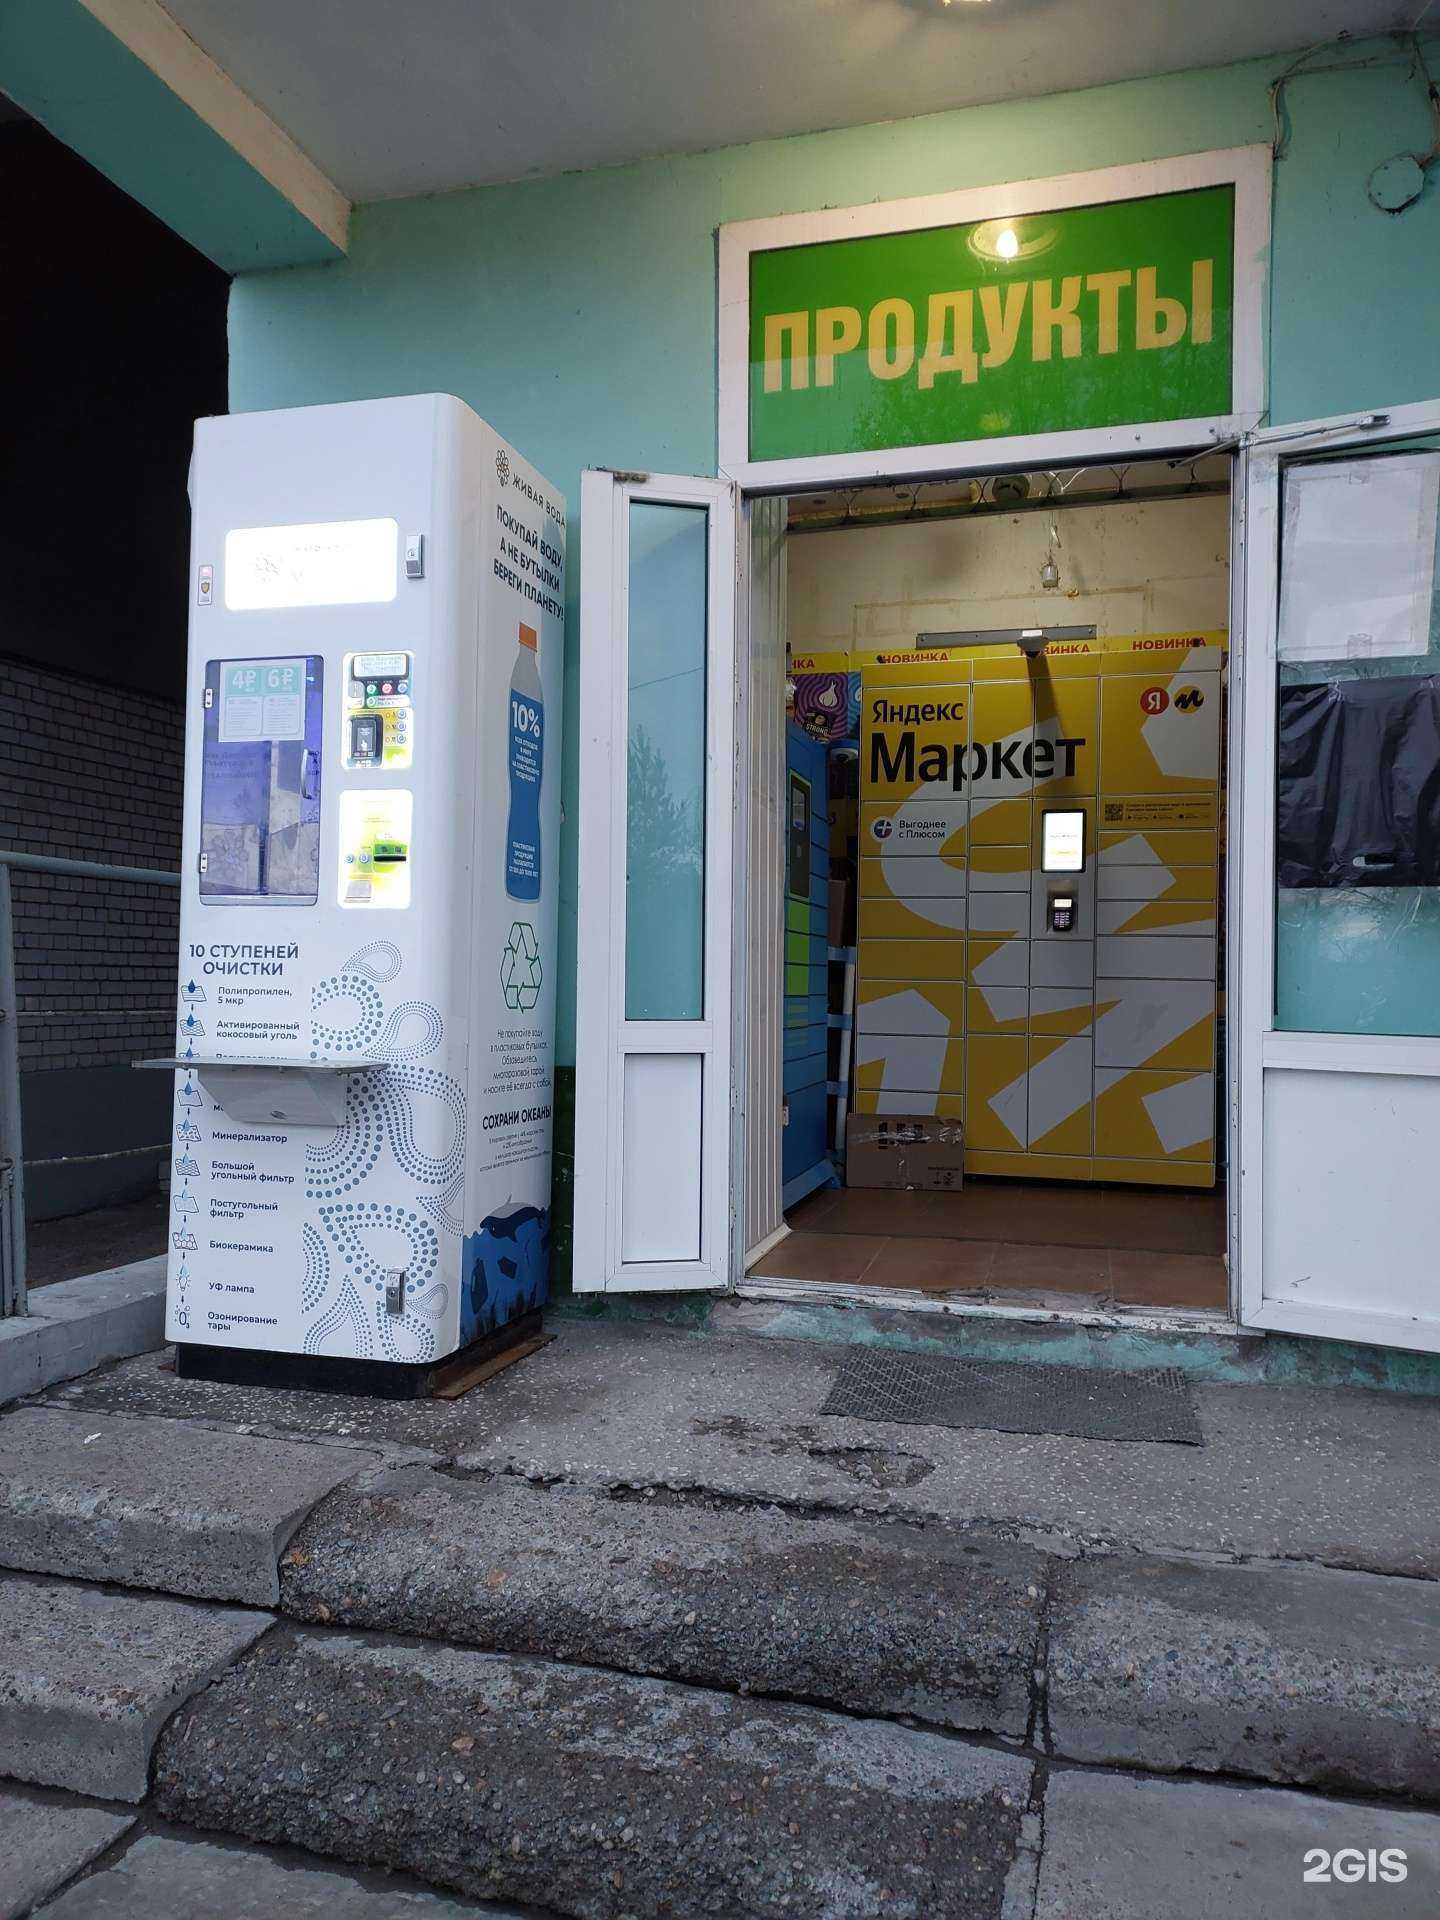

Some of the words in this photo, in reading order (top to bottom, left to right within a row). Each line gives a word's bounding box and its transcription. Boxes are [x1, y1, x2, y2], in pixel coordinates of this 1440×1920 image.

[763, 259, 1214, 394] ПРОДУКТЫ
[512, 473, 544, 509] ЖИВАЯ
[545, 501, 566, 529] ВОДА
[496, 503, 539, 550] ПОКУПАЙ
[540, 538, 563, 573] ВОДУ,
[500, 537, 507, 555] А
[508, 541, 519, 564] НЕ
[520, 551, 560, 593] БУТЫЛКИ
[493, 558, 522, 594] БЕРЕГИ
[524, 583, 564, 621] ПЛАНЕТУ!
[1132, 636, 1207, 651] НОВИНКА
[882, 651, 949, 664] НОВИНКА
[1147, 691, 1161, 710] Я
[871, 699, 964, 725] Яндекс
[512, 700, 541, 738] 10%
[805, 722, 829, 735] STRONG
[870, 731, 1086, 792] Маркет
[899, 819, 947, 831] Выгоднее
[906, 830, 945, 839] Плюсом
[189, 944, 206, 957] 10
[209, 942, 299, 959] СТУПЕНЕЙ
[203, 961, 283, 976] ОЧИСТКИ
[218, 986, 293, 997] Полипропилен,
[217, 996, 223, 1004] 5
[225, 997, 244, 1006] мкр
[216, 1020, 300, 1030] Активированный
[216, 1030, 268, 1039] кокосовый
[270, 1032, 298, 1041] уголь
[482, 1110, 520, 1130] СОХРАНИ
[212, 1131, 288, 1144] Минерализатор
[211, 1160, 255, 1171] Большой
[211, 1171, 257, 1181] угольный
[258, 1173, 295, 1184] фильтр
[210, 1199, 279, 1212] Постугольный
[209, 1208, 245, 1219] фильтр
[209, 1240, 274, 1253] Биокерамика
[208, 1282, 223, 1291] УФ
[224, 1284, 255, 1294] лампа
[207, 1311, 278, 1325] Озонирование
[207, 1322, 231, 1332] тары
